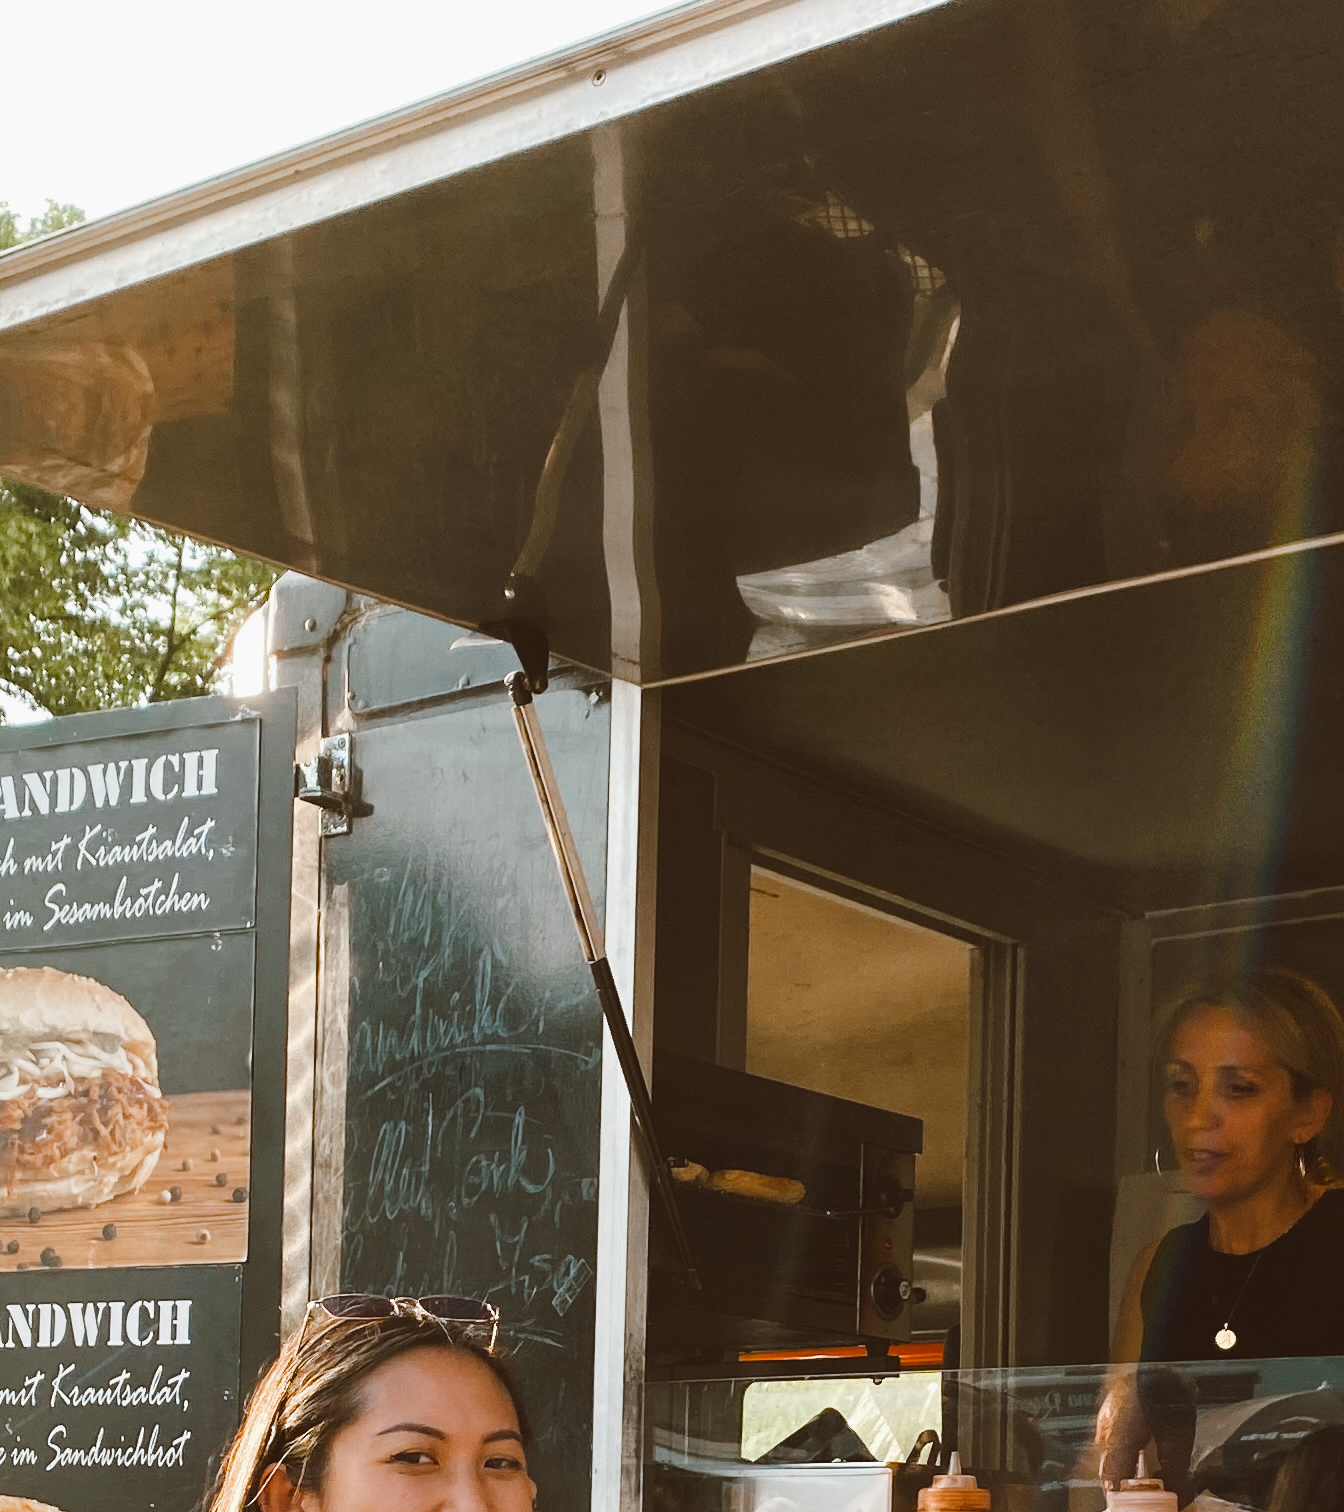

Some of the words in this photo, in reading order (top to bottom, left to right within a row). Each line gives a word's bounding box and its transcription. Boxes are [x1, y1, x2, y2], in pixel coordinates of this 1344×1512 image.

[23, 833, 72, 875] mit
[77, 816, 216, 870] Krautsalat,
[2, 898, 34, 930] im
[43, 872, 211, 931] Sesambrötchen
[50, 1363, 191, 1411] Krautsalat,
[10, 1435, 39, 1466] im
[46, 1424, 192, 1472] Sandwichbrot
